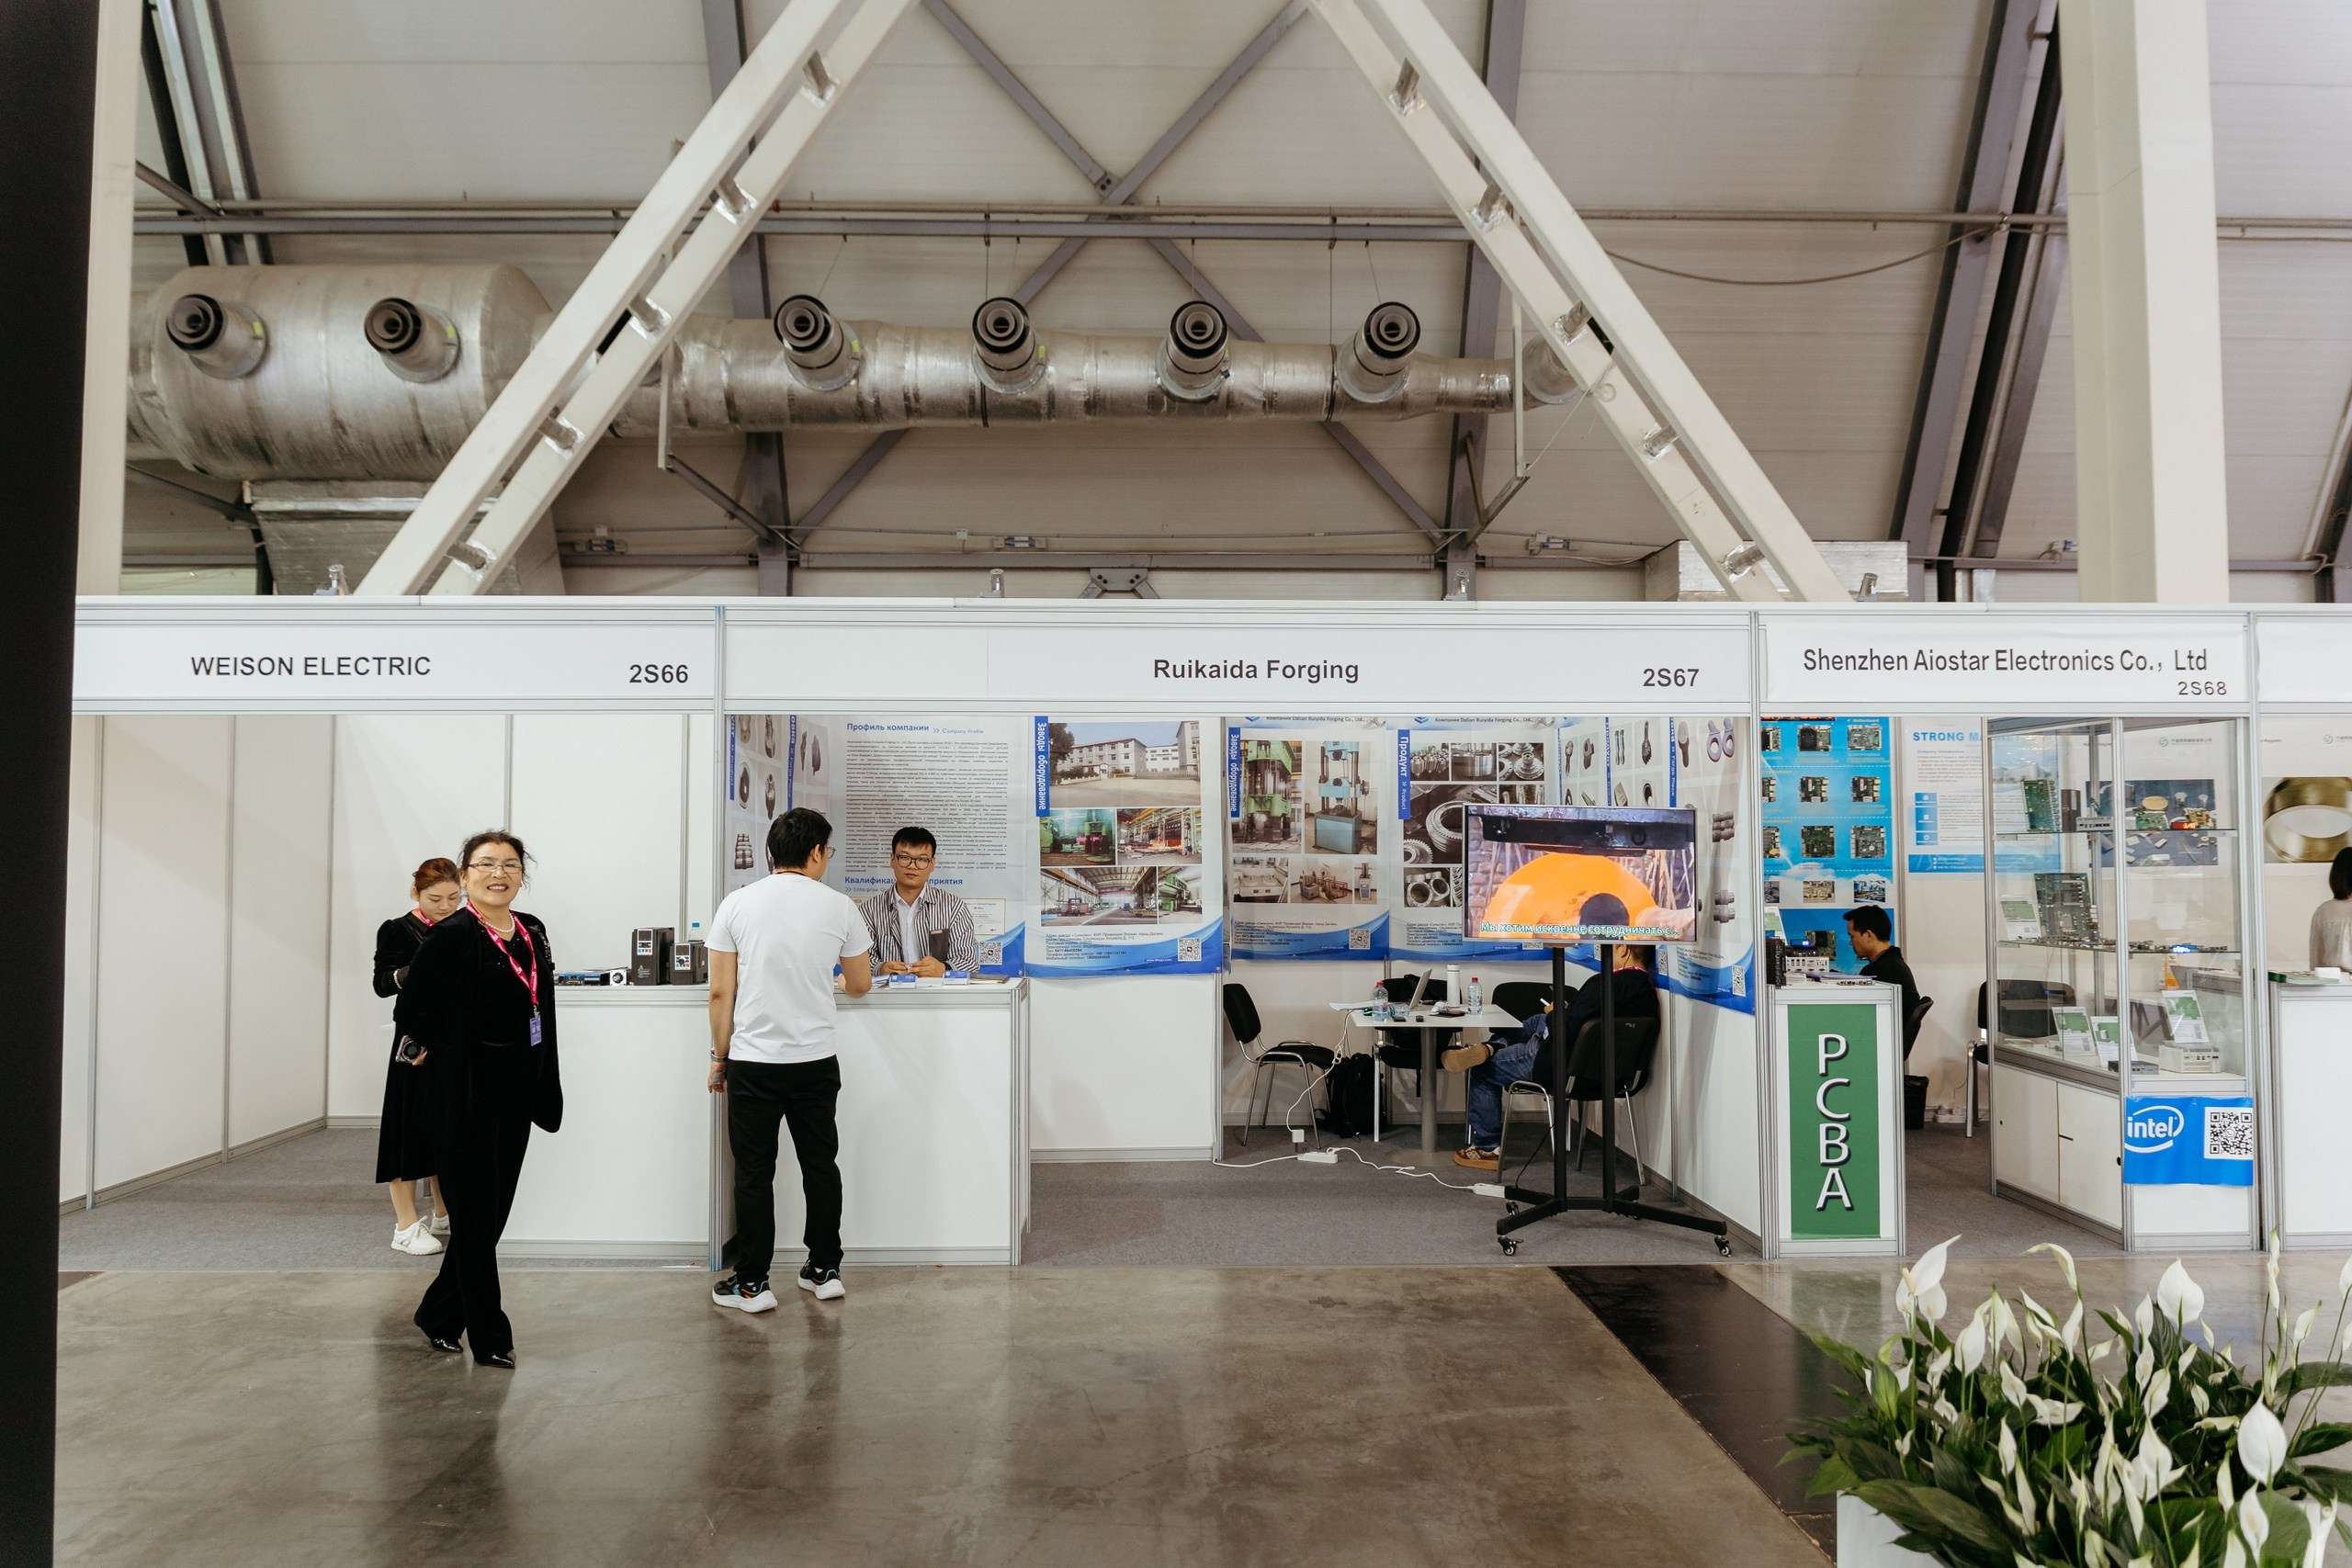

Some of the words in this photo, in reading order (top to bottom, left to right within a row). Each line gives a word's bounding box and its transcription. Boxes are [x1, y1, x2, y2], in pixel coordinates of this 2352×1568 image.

[191, 656, 293, 676] WEISON
[304, 656, 432, 676] ELECTRIC
[1804, 648, 1908, 671] Shenzhen
[1914, 649, 1990, 671] Aiostar
[1995, 649, 2115, 671] Electronics
[2175, 649, 2209, 671] Ltd
[629, 663, 689, 685] 2S66
[1154, 659, 1259, 679] Ruikaida
[1267, 660, 1360, 684] Forging
[1644, 668, 1701, 687] 2S67
[2178, 681, 2228, 696] 2S68
[846, 723, 885, 732] Профиль
[1036, 722, 1047, 751] Заводы
[1913, 731, 1965, 742] STRONG
[1229, 734, 1239, 760] Заводы
[1398, 736, 1409, 777] Продукт
[1036, 755, 1048, 810] оборудование
[1229, 763, 1240, 812] оборудование
[1481, 922, 1498, 932] Мы
[1498, 924, 1532, 932] хотим
[1535, 924, 1586, 935] искренне
[1588, 925, 1663, 937] сотрудничать
[1815, 1032, 1854, 1212] PCBA
[2127, 1116, 2174, 1138] intel
